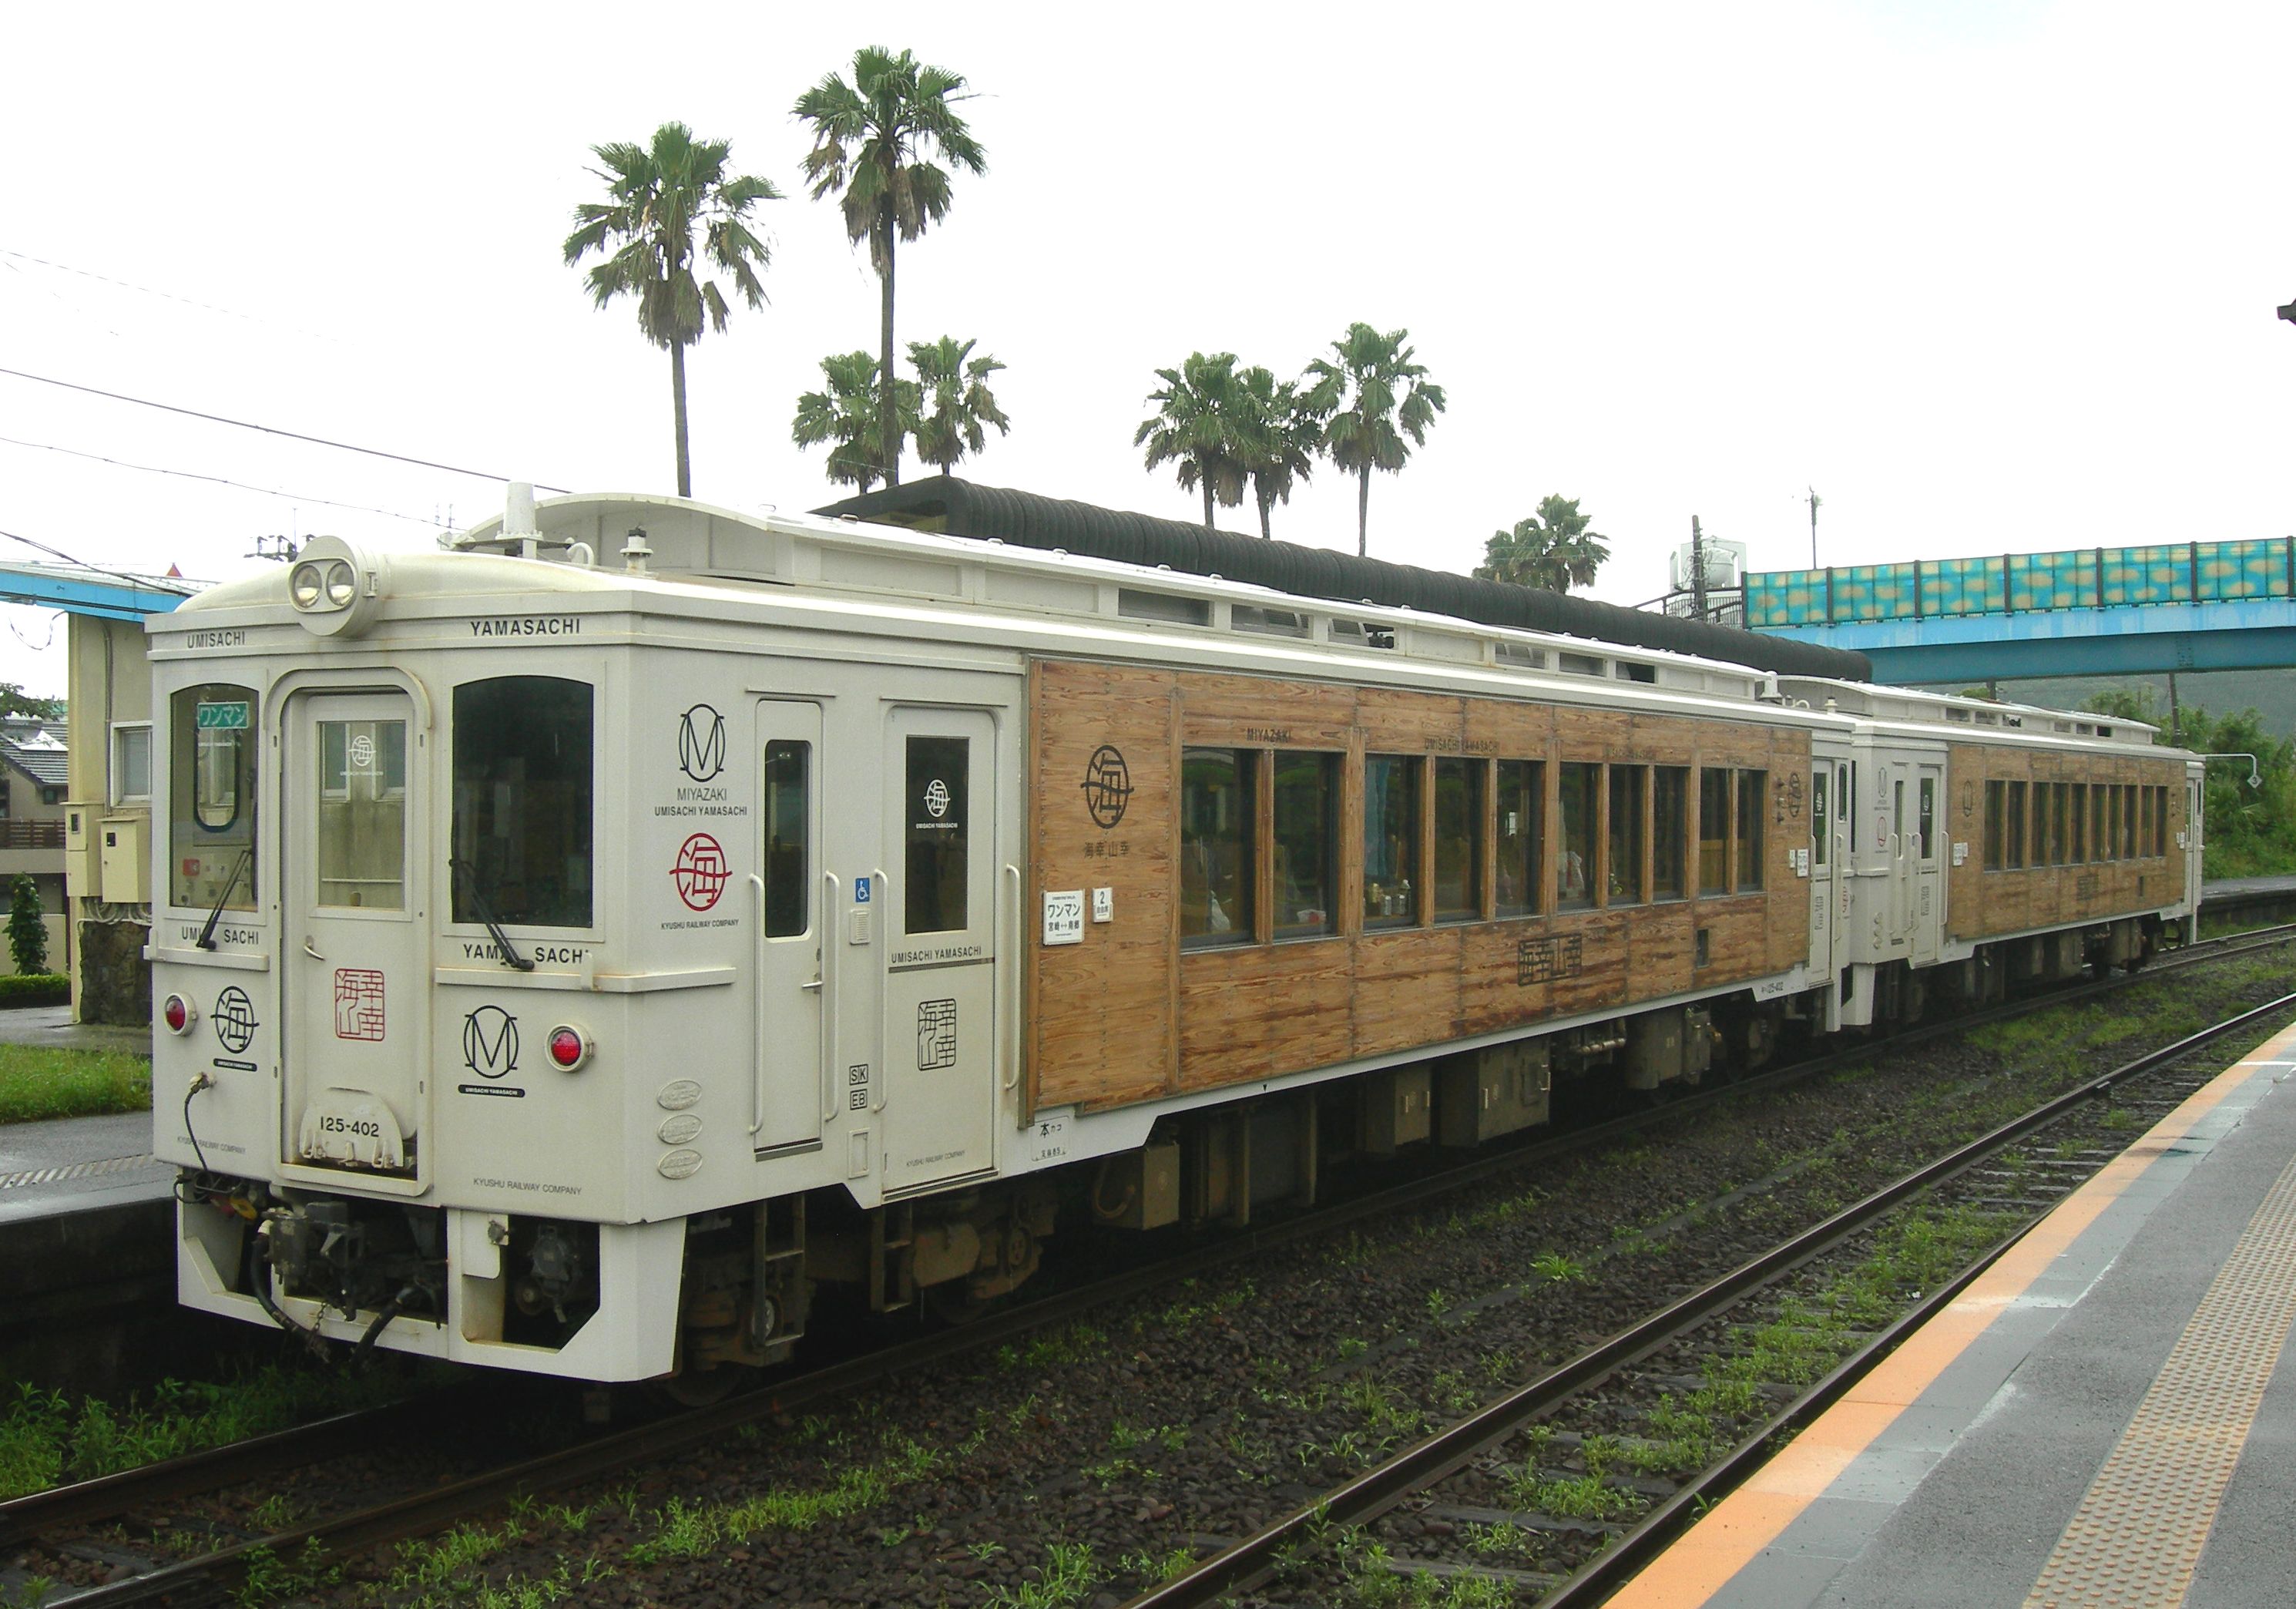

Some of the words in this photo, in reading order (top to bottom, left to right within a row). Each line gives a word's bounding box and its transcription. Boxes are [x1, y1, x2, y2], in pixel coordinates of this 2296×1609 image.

[471, 618, 580, 636] YAMASACHI
[187, 631, 246, 649] UMISACHI
[200, 705, 247, 727] ワンマン
[1247, 727, 1291, 743] MIYAZAKI
[677, 788, 727, 801] MIYAZAKI
[655, 806, 697, 816] UMISACHI
[698, 805, 747, 816] YAMASACHI
[1099, 891, 1105, 905] 2
[1048, 904, 1080, 919] ワンマン
[661, 922, 686, 930] KYUSHU
[713, 919, 739, 928] COMPANY
[223, 929, 259, 945] SACHI
[891, 949, 932, 963] UMISACHI
[935, 946, 982, 959] YAMASACHI
[852, 1093, 865, 1107] EB
[321, 1116, 379, 1137] 125-402
[473, 1177, 505, 1188] KYUSHU
[507, 1180, 540, 1191] RAILWAY
[542, 1184, 582, 1195] COMPANY
